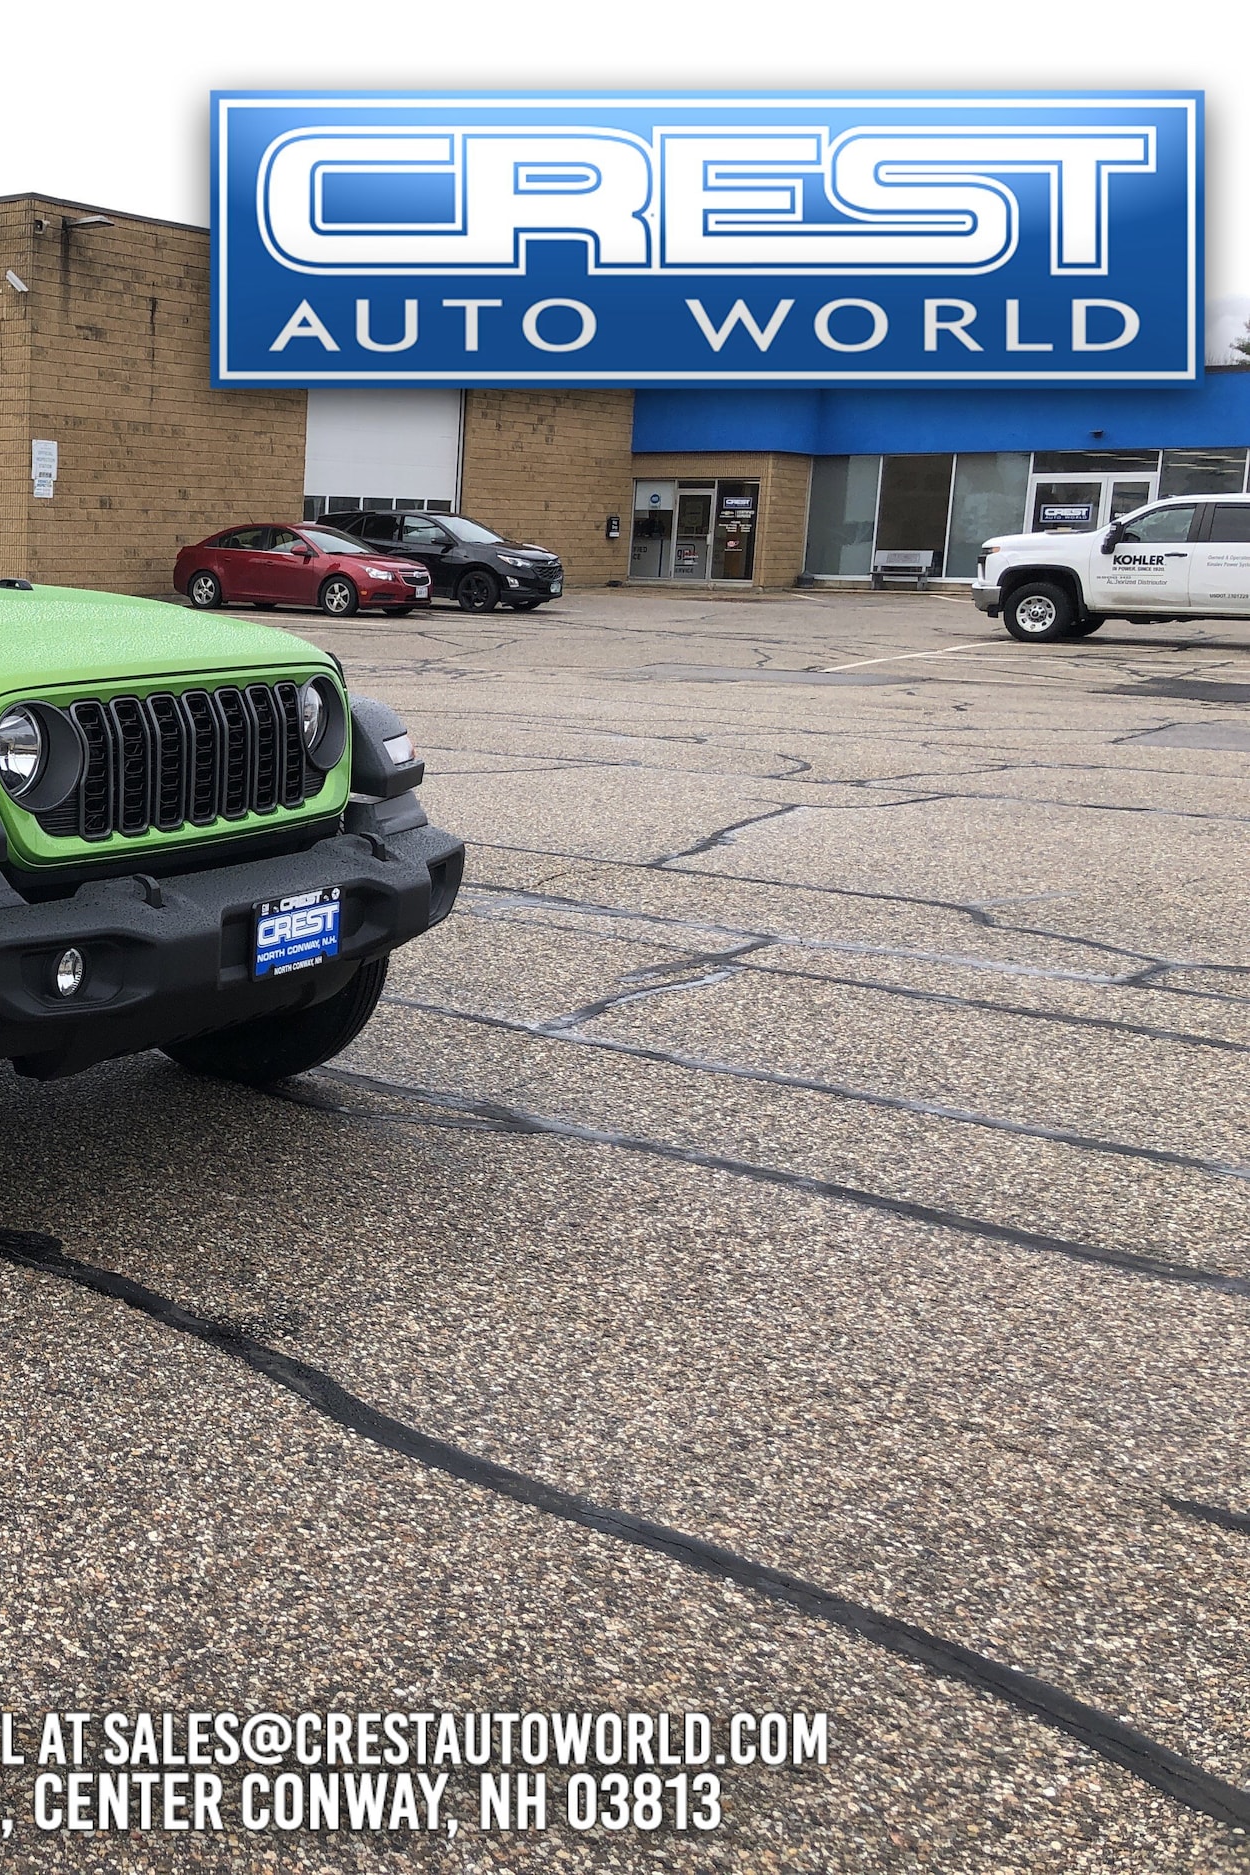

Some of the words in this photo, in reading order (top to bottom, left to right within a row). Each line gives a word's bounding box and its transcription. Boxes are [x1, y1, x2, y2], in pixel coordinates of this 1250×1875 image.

[1044, 508, 1089, 516] CREST
[1112, 554, 1165, 566] KOHLER
[280, 890, 323, 912] CREST
[257, 902, 340, 948] CREST
[256, 948, 285, 963] NORTH
[287, 938, 321, 957] CONWAY,
[321, 935, 338, 947] N.H.
[273, 964, 293, 976] NORTH
[292, 958, 315, 971] CONWAY,
[314, 956, 323, 965] NH
